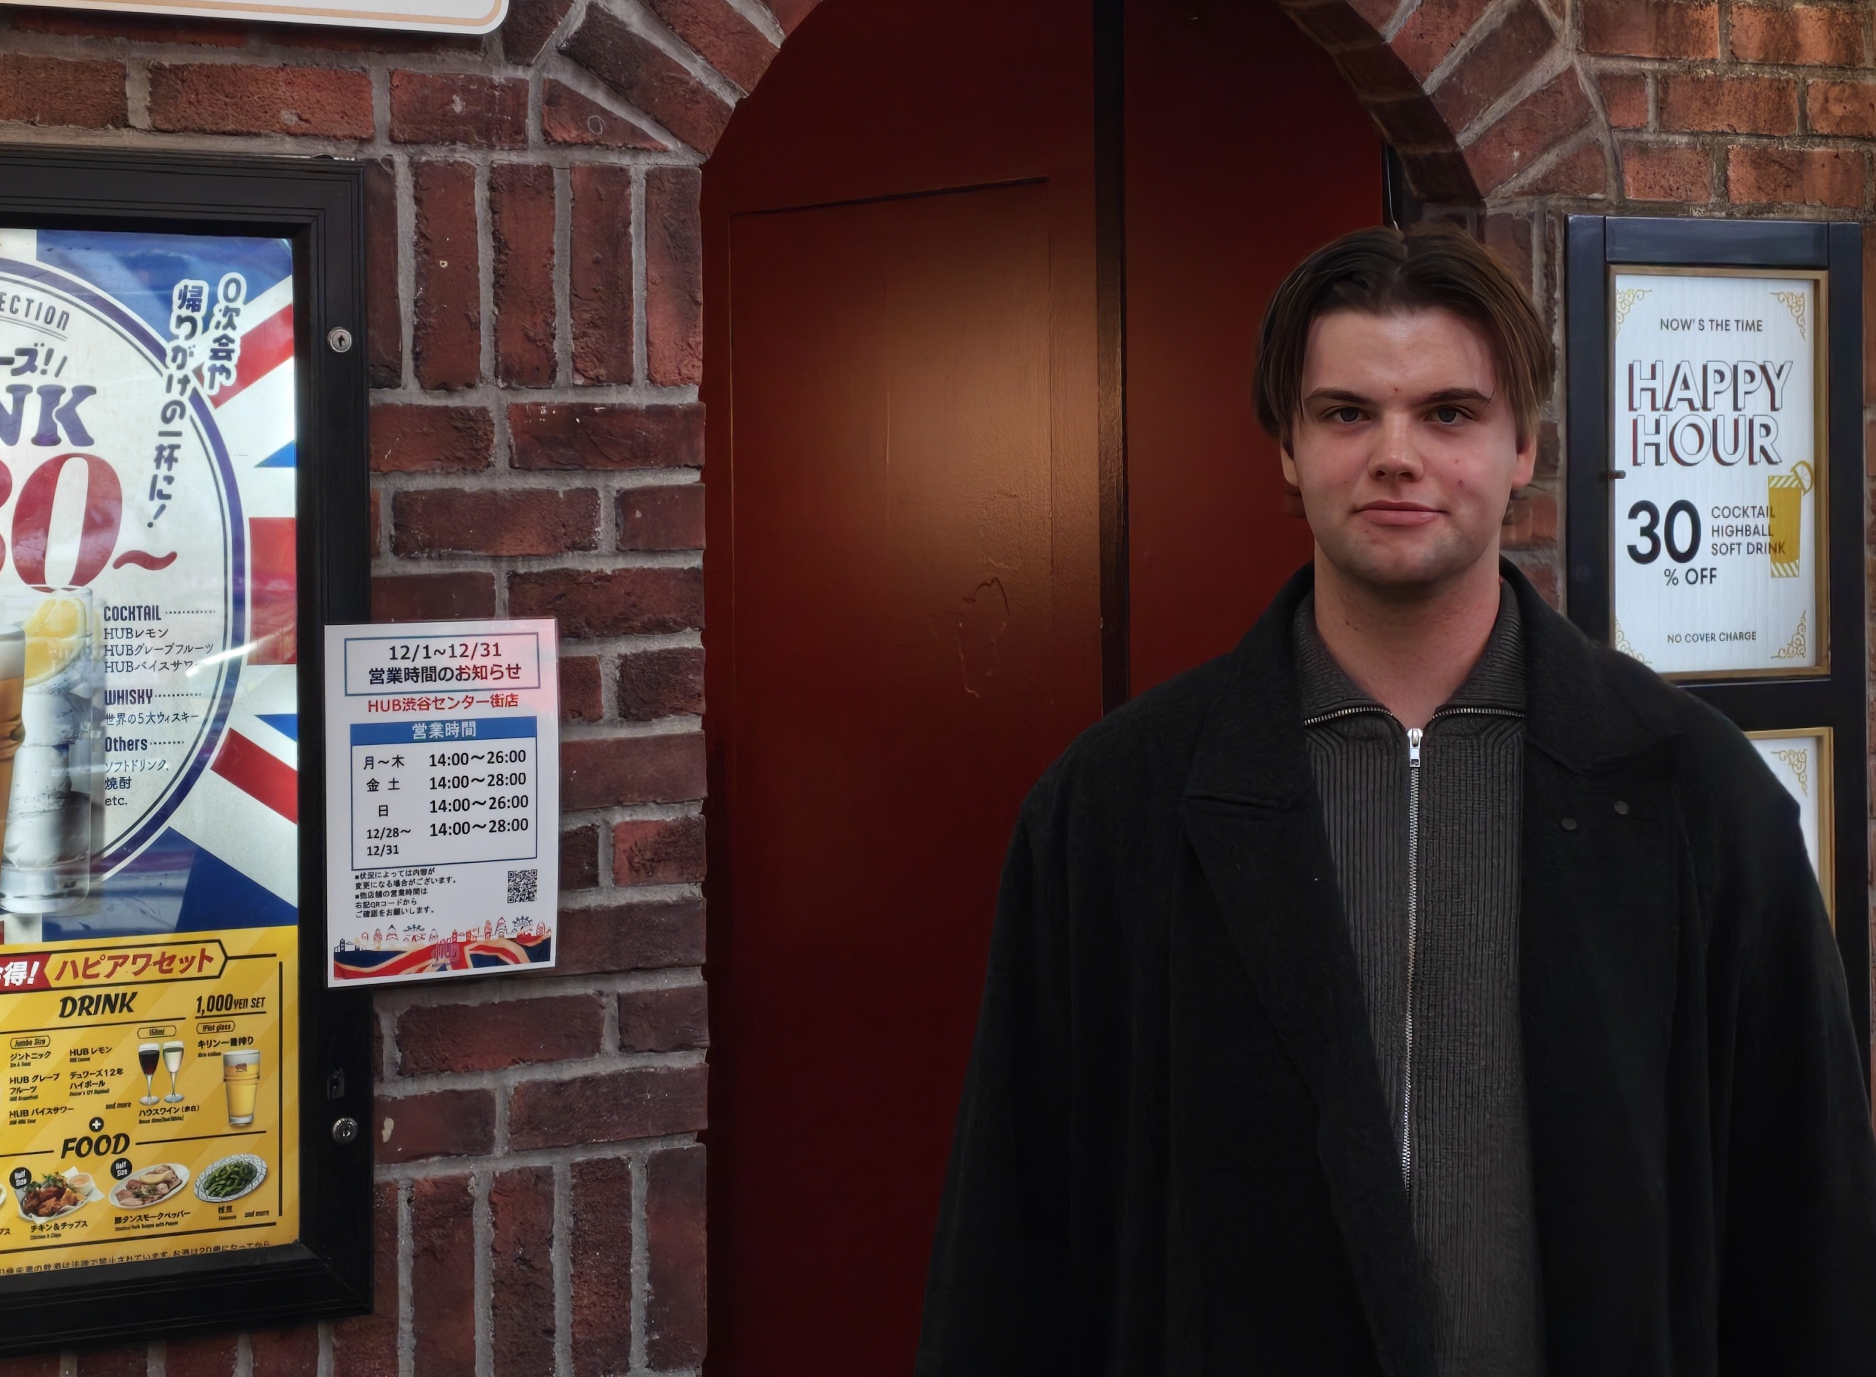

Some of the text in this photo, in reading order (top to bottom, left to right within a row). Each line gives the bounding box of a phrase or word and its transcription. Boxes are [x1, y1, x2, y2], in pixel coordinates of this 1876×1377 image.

[1710, 319, 1730, 332] THE
[1735, 319, 1763, 333] TIME
[1628, 360, 1793, 412] HAPPY
[1632, 414, 1783, 466] HOUR
[1711, 506, 1776, 519] COCKTAIL
[1627, 500, 1701, 565] 30
[1711, 524, 1774, 538] HIGHBALL
[1711, 542, 1786, 556] SOFT DRINK
[1664, 568, 1717, 586] % OFF
[103, 605, 161, 621] COCKTAIL
[103, 627, 169, 640] HUBレモン
[1667, 631, 1757, 644] NO COVER CHARGE
[103, 642, 214, 656] HUBグレープフルーツ
[368, 663, 522, 685] 営業時間のお知らせ
[104, 689, 153, 706] WHISKY
[367, 693, 519, 713] HUB渋谷センター街店
[104, 711, 199, 726] 世界の5大ウィスキー
[412, 721, 477, 740] 営業時間
[104, 736, 148, 752] Others
[104, 775, 132, 790] 焼酎
[366, 778, 380, 792] 金
[388, 778, 401, 791] 土
[104, 796, 128, 806] etc.
[378, 804, 389, 817] 日
[366, 845, 400, 857] 12/31
[54, 948, 214, 981] ハピアワセット
[58, 991, 138, 1018] DRINK
[250, 997, 266, 1008] SET
[10, 1050, 52, 1061] ジントニック
[69, 1046, 113, 1056] HUB レモン
[9, 1075, 30, 1084] HUB
[9, 1109, 29, 1118] HUB
[60, 1132, 130, 1159] FOOD
[115, 1161, 127, 1170] Half
